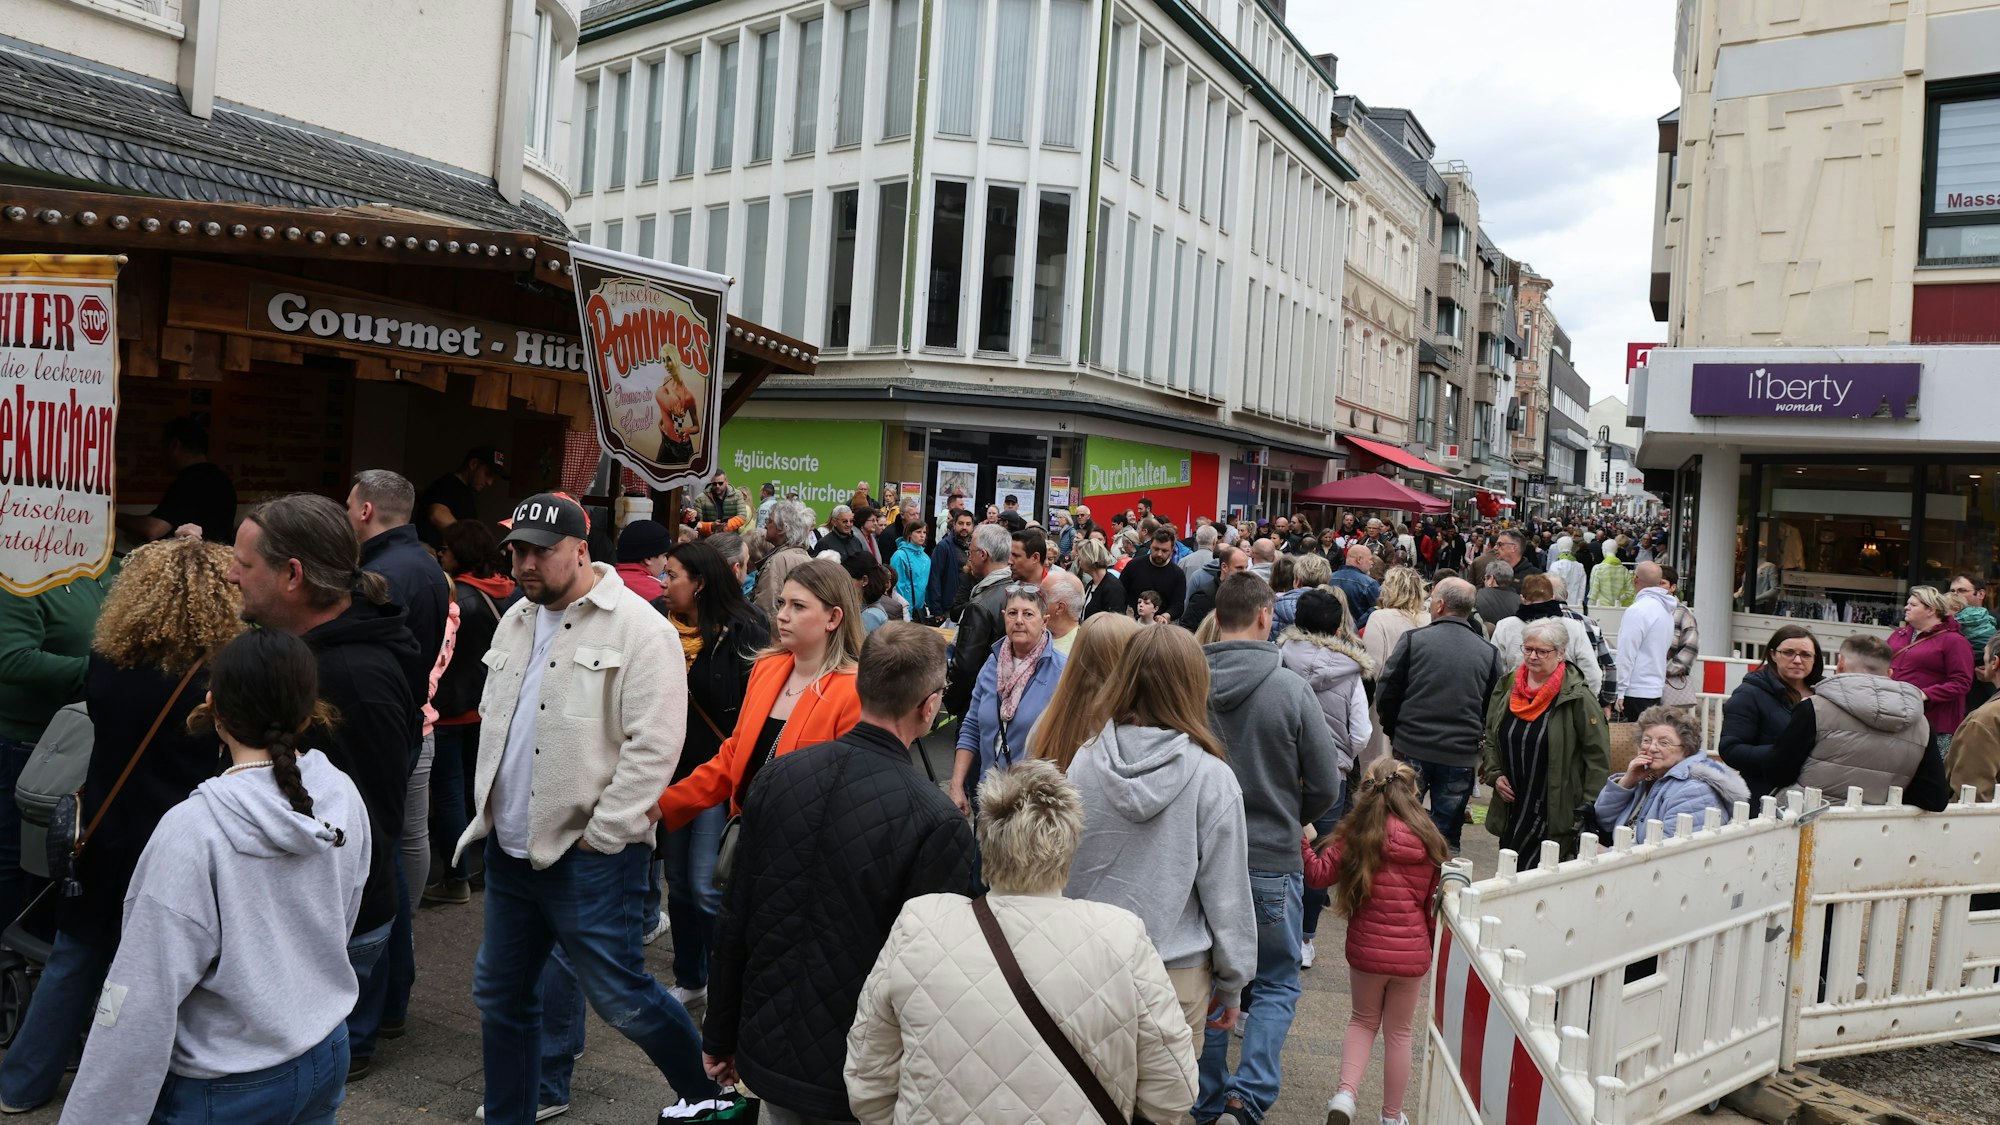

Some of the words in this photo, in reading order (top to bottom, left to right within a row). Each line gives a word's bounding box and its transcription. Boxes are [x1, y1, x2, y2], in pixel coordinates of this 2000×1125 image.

[607, 276, 665, 308] Frische
[0, 293, 75, 351] HIER
[81, 309, 106, 330] STOP
[267, 292, 481, 356] Gourmet
[586, 292, 711, 393] Pommes
[1, 351, 29, 379] die
[34, 352, 104, 385] leckeren
[1749, 368, 1853, 407] liberty
[1775, 402, 1823, 412] woman
[1058, 422, 1066, 430] 14
[734, 449, 819, 472] #glücksorte
[1089, 459, 1176, 491] Durchhalten...
[0, 488, 93, 525] frischen
[512, 503, 559, 524] ICON
[0, 525, 88, 564] rtoffeln
